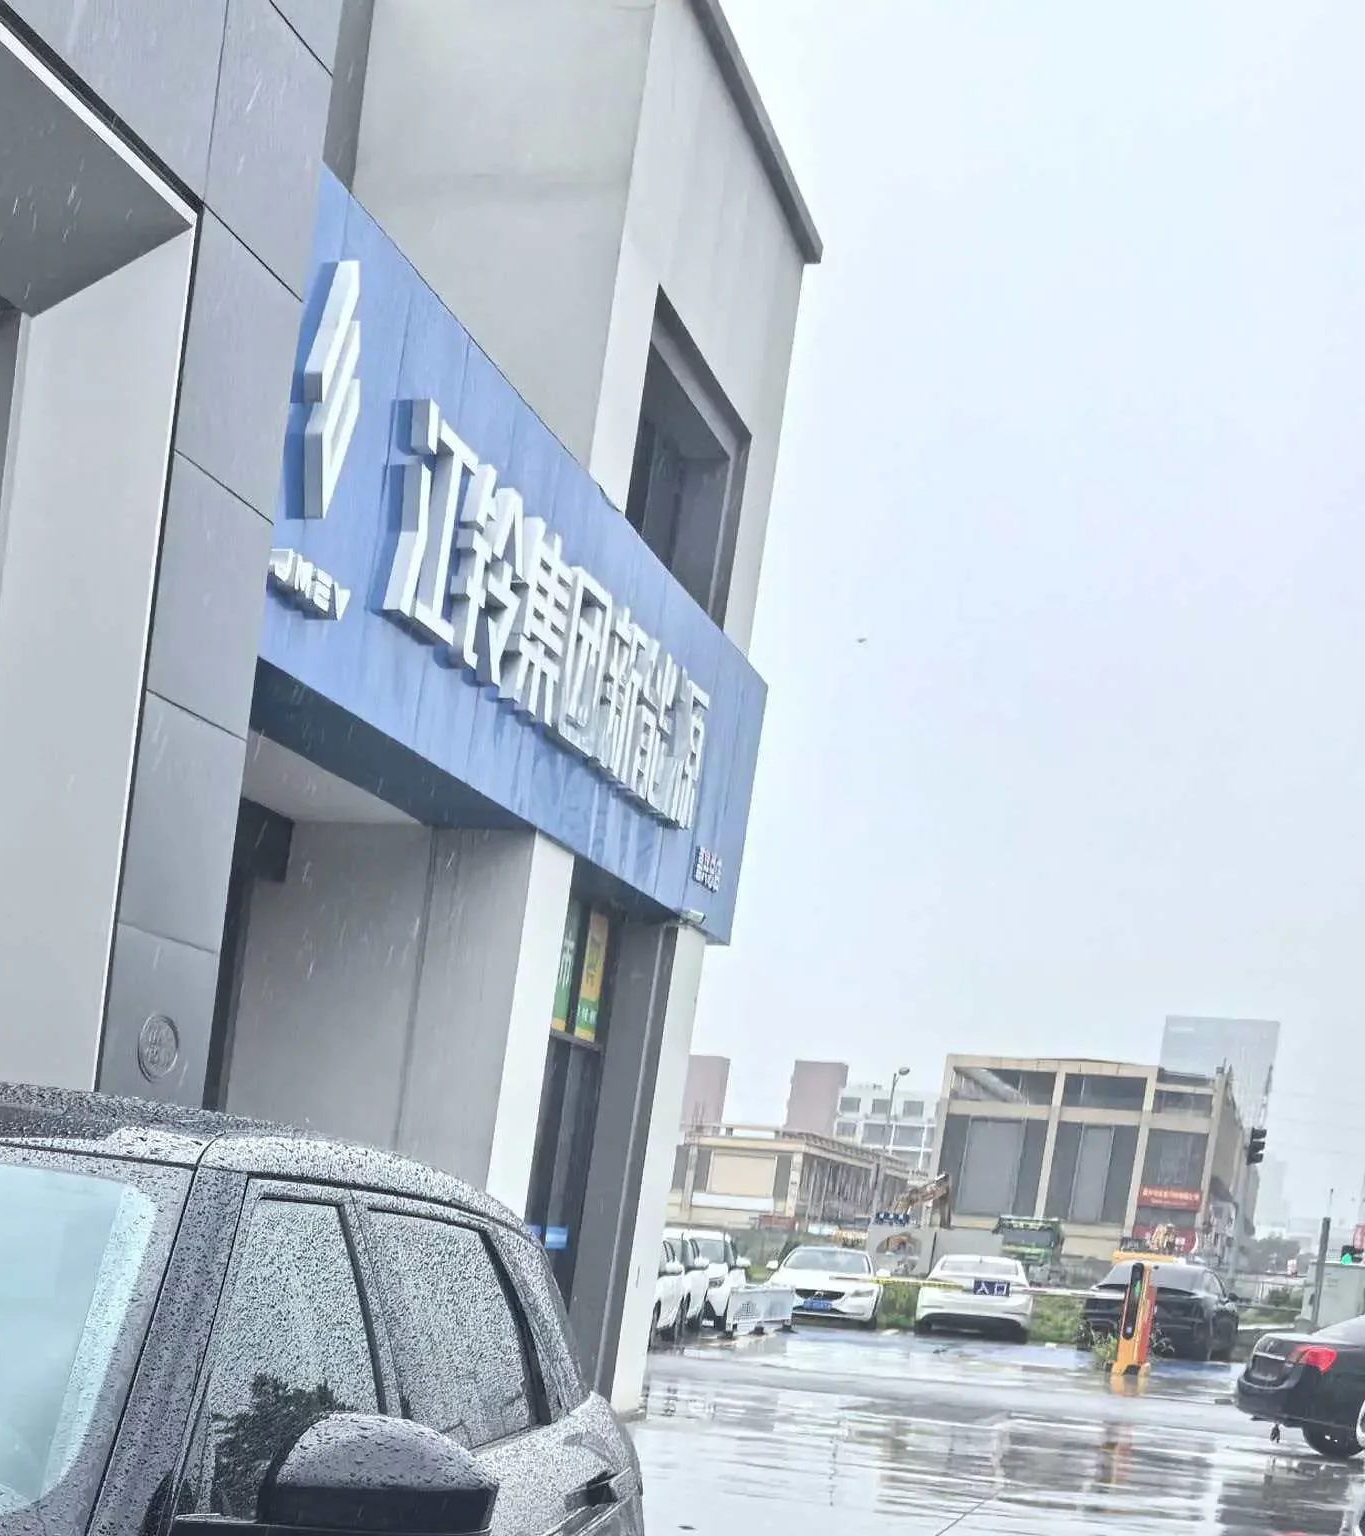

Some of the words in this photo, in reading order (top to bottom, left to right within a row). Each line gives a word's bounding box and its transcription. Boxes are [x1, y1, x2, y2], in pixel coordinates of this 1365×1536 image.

[383, 399, 710, 828] 江铃集团新能源
[976, 1281, 1007, 1296] 入口
